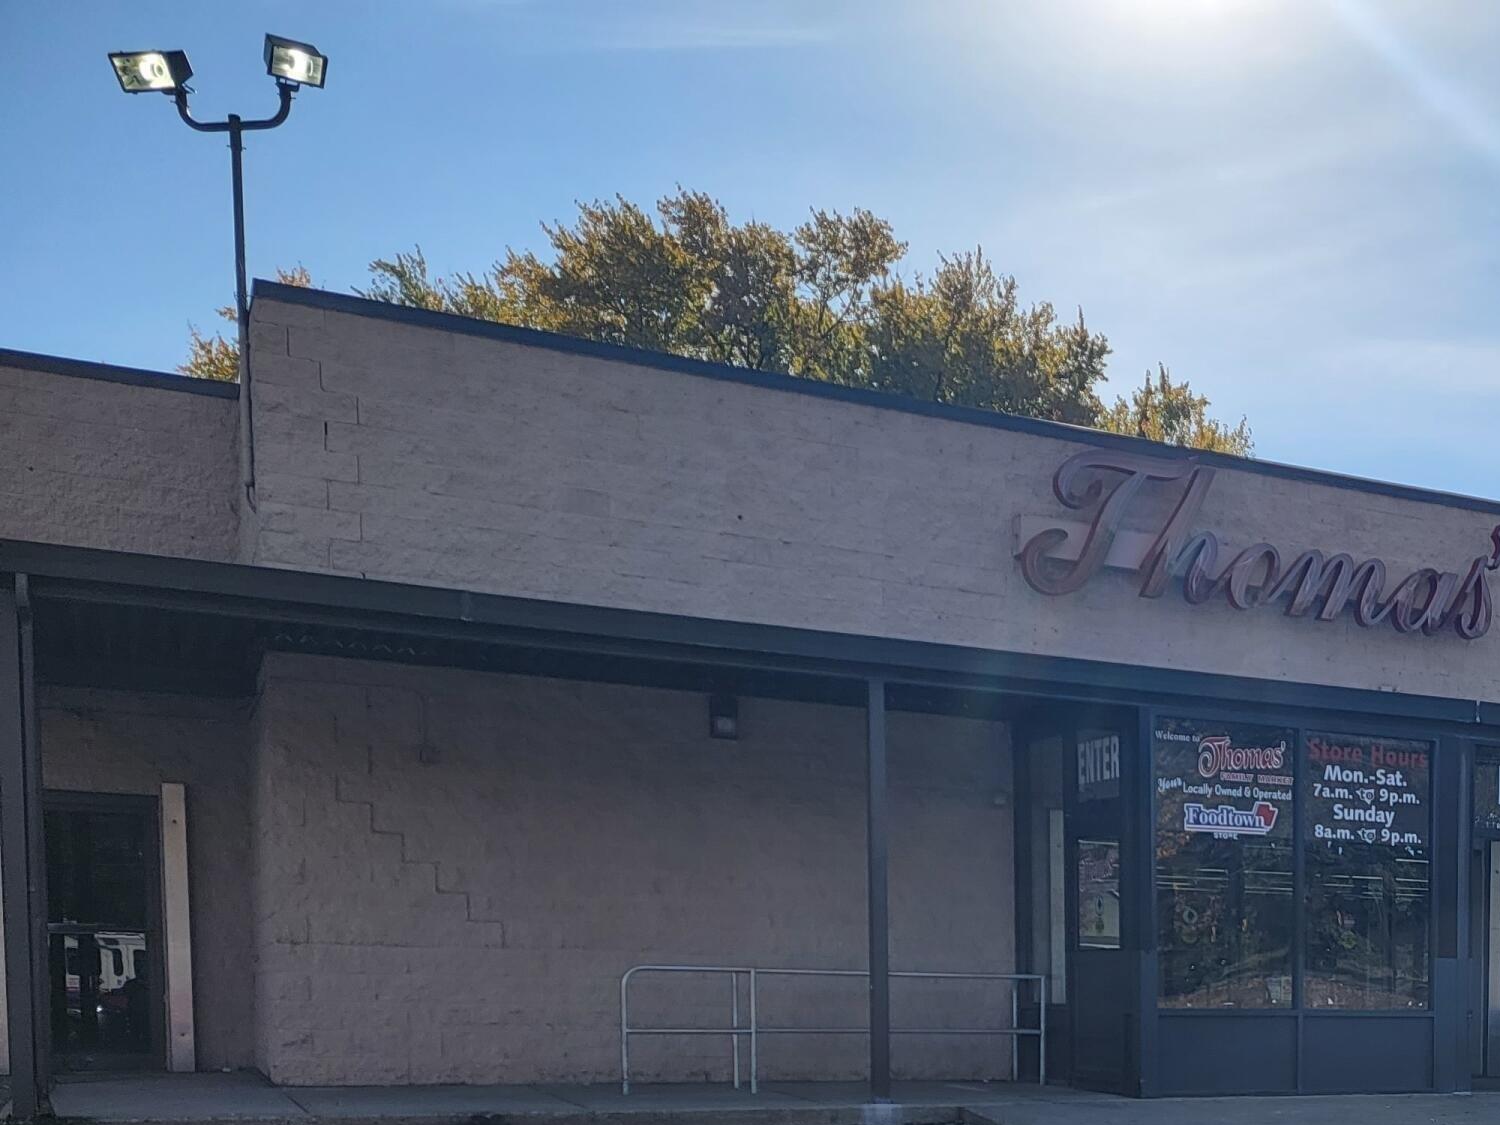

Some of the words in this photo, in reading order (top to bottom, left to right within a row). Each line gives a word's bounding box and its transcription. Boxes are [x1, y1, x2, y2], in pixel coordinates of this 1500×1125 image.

[1155, 730, 1190, 742] Welcome
[1192, 733, 1200, 743] to
[1077, 735, 1120, 785] ENTER
[1198, 736, 1286, 778] Thomas'
[1307, 739, 1363, 761] Store
[1370, 742, 1428, 768] Hours
[1220, 771, 1254, 783] FAMILY
[1323, 764, 1408, 787] Mon.-Sat.
[1182, 781, 1213, 798] Locally
[1214, 784, 1242, 798] Owned
[1252, 787, 1292, 801] Operated
[1313, 783, 1353, 800] 7a.m.
[1379, 788, 1420, 807] 9p.m.
[1186, 806, 1266, 829] Foodtown
[1333, 803, 1395, 828] Sunday
[1314, 824, 1355, 841] 8a.m.
[1381, 828, 1422, 847] 9p.m.
